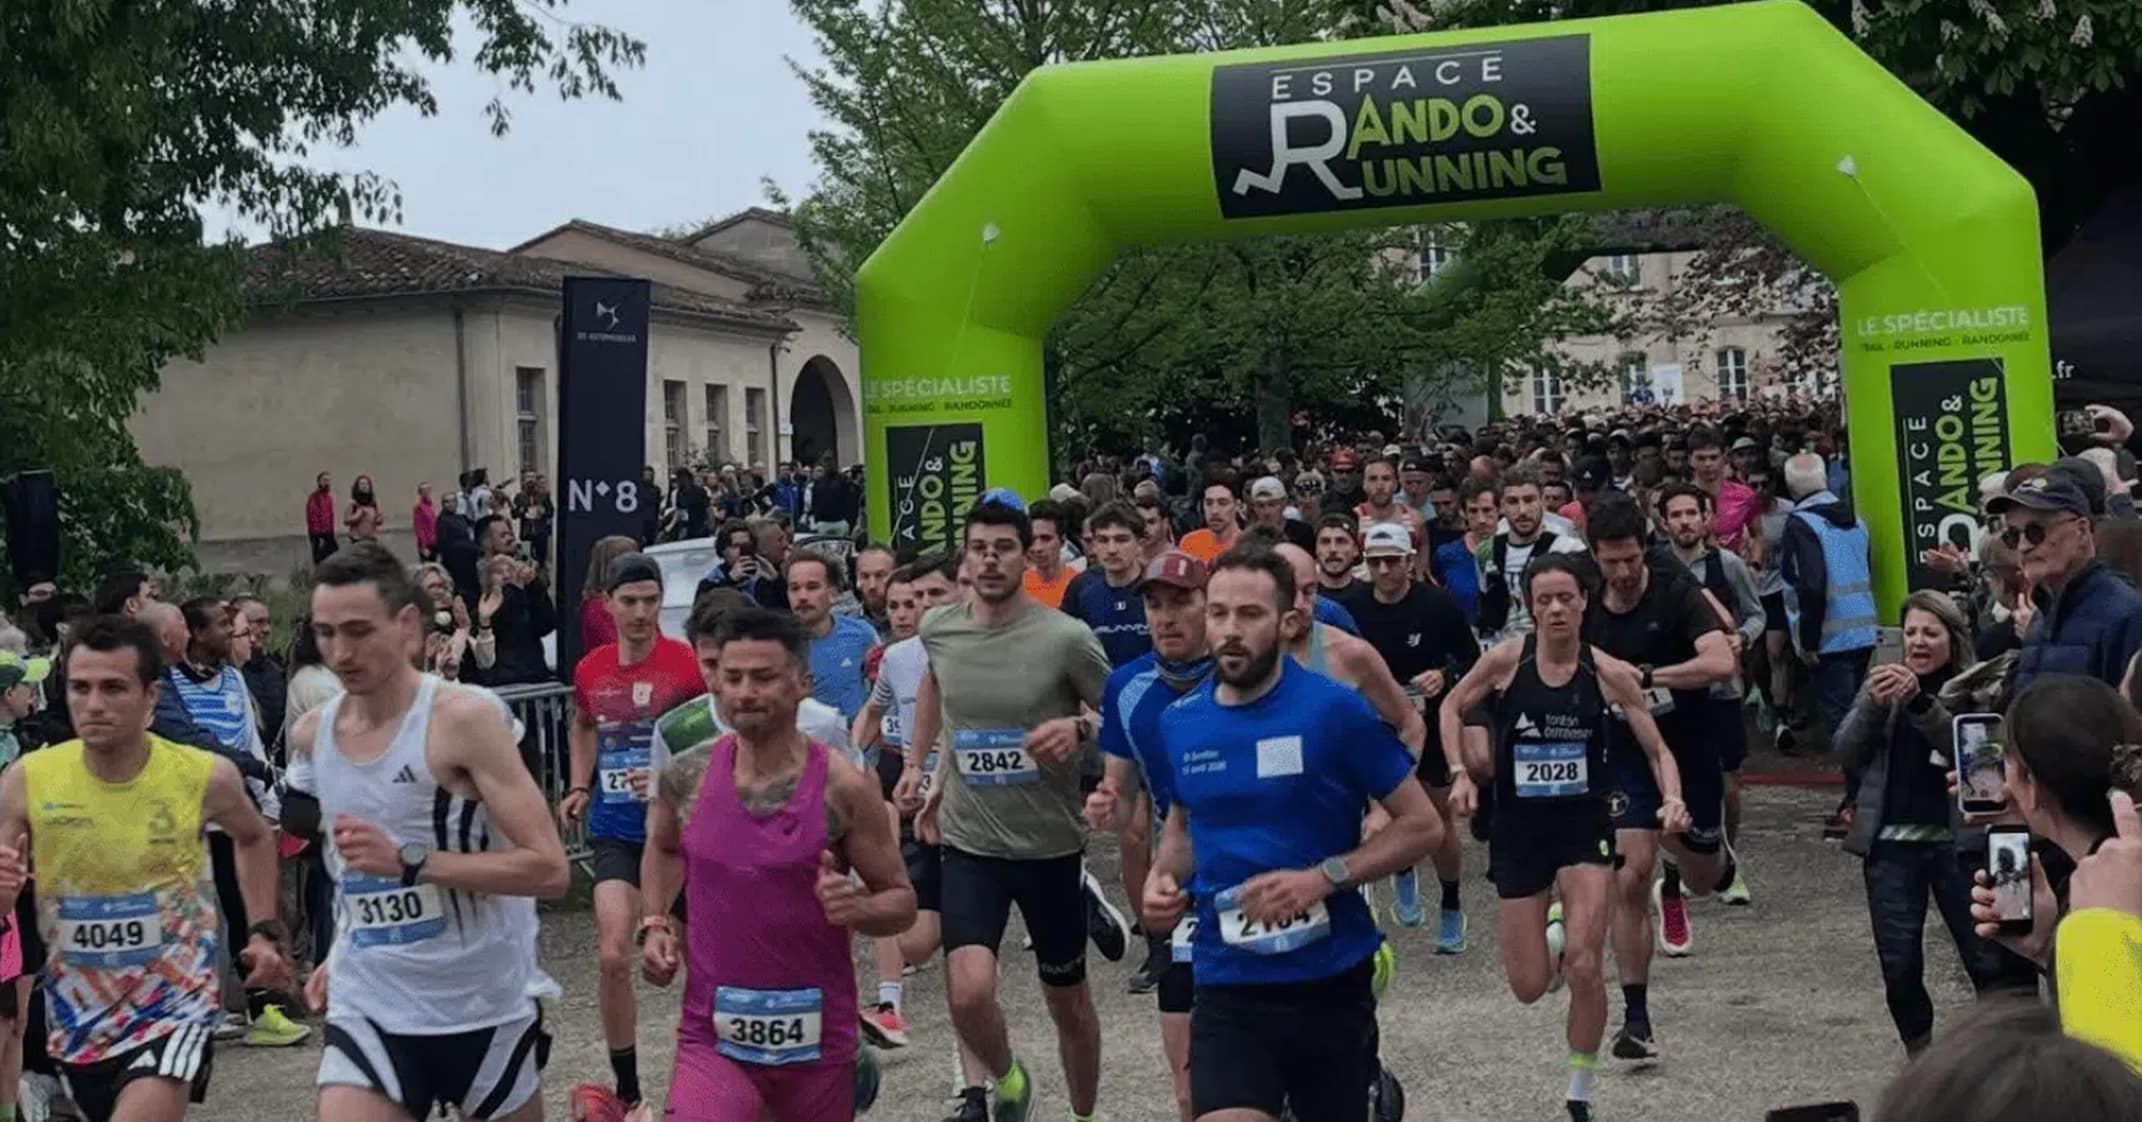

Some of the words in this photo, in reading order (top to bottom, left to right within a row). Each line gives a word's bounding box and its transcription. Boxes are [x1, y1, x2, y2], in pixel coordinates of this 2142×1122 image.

[1271, 57, 1503, 99] ESPACE
[1510, 103, 1537, 135] &
[1856, 317, 1879, 336] LE
[1884, 305, 2029, 334] SPÉCIALISTE
[1940, 394, 1963, 411] &
[924, 456, 943, 472] &
[967, 751, 1025, 773] 2842
[1526, 762, 1579, 782] 2028
[357, 890, 423, 924] 3130
[72, 921, 145, 949] 4049
[729, 1017, 804, 1046] 3864
